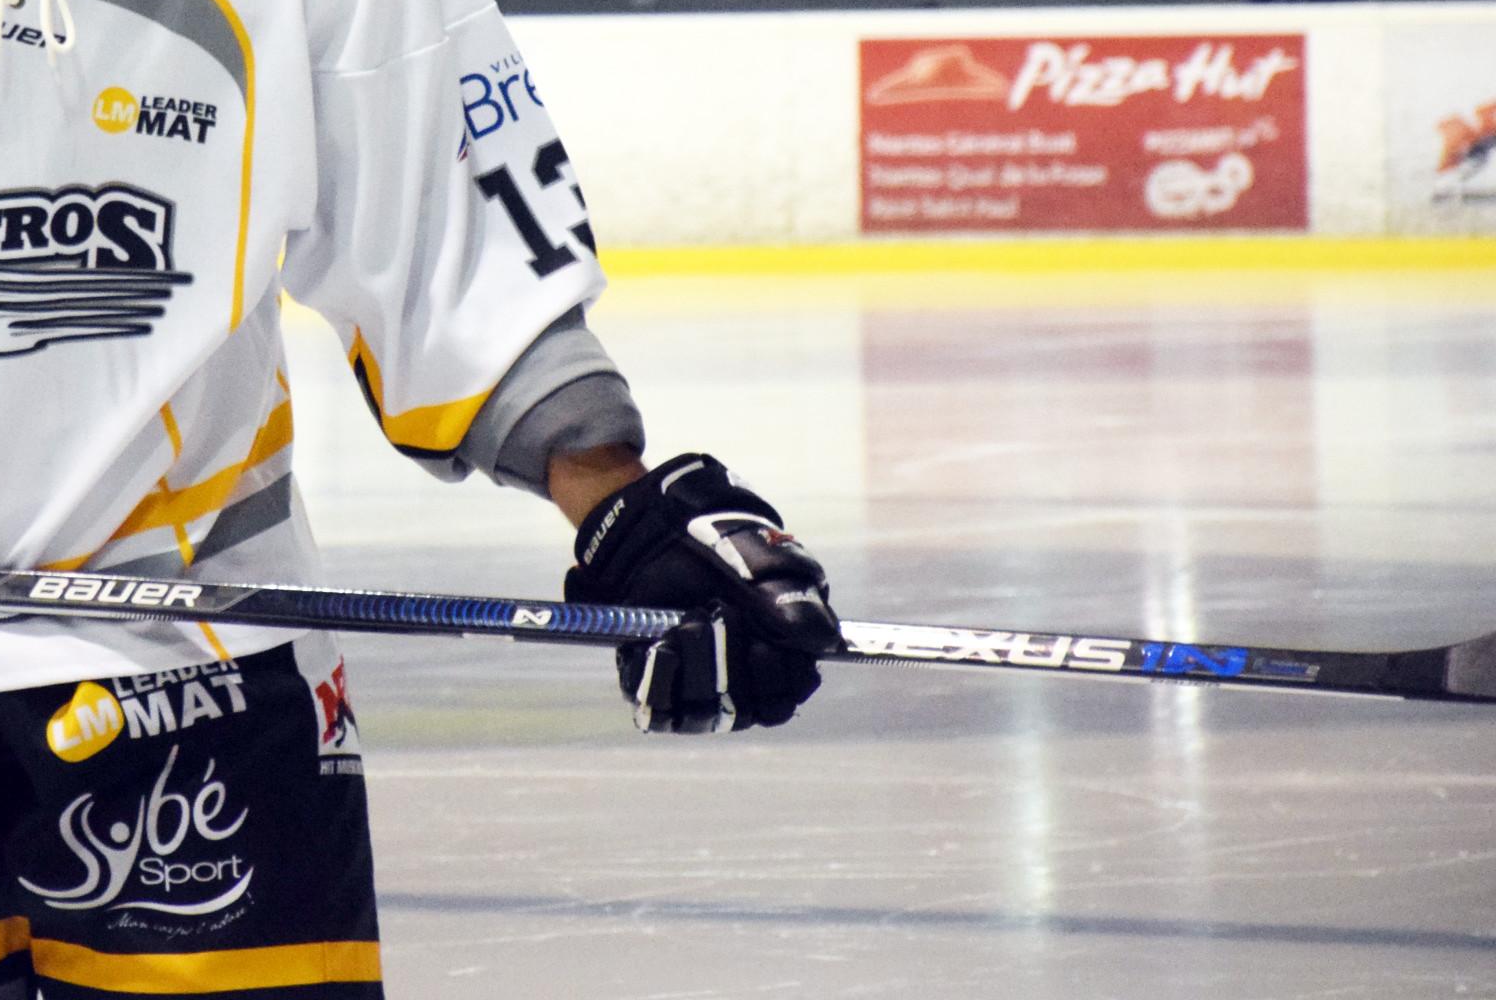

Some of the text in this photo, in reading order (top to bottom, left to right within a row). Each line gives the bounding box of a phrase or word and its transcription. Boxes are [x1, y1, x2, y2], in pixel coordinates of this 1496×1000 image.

[1008, 41, 1298, 111] Pizza Hut
[95, 98, 136, 124] LM
[140, 96, 217, 119] LEADER
[135, 110, 216, 144] MAT
[53, 696, 119, 750] LM
[121, 672, 247, 739] MAT
[139, 856, 242, 892] Sport
